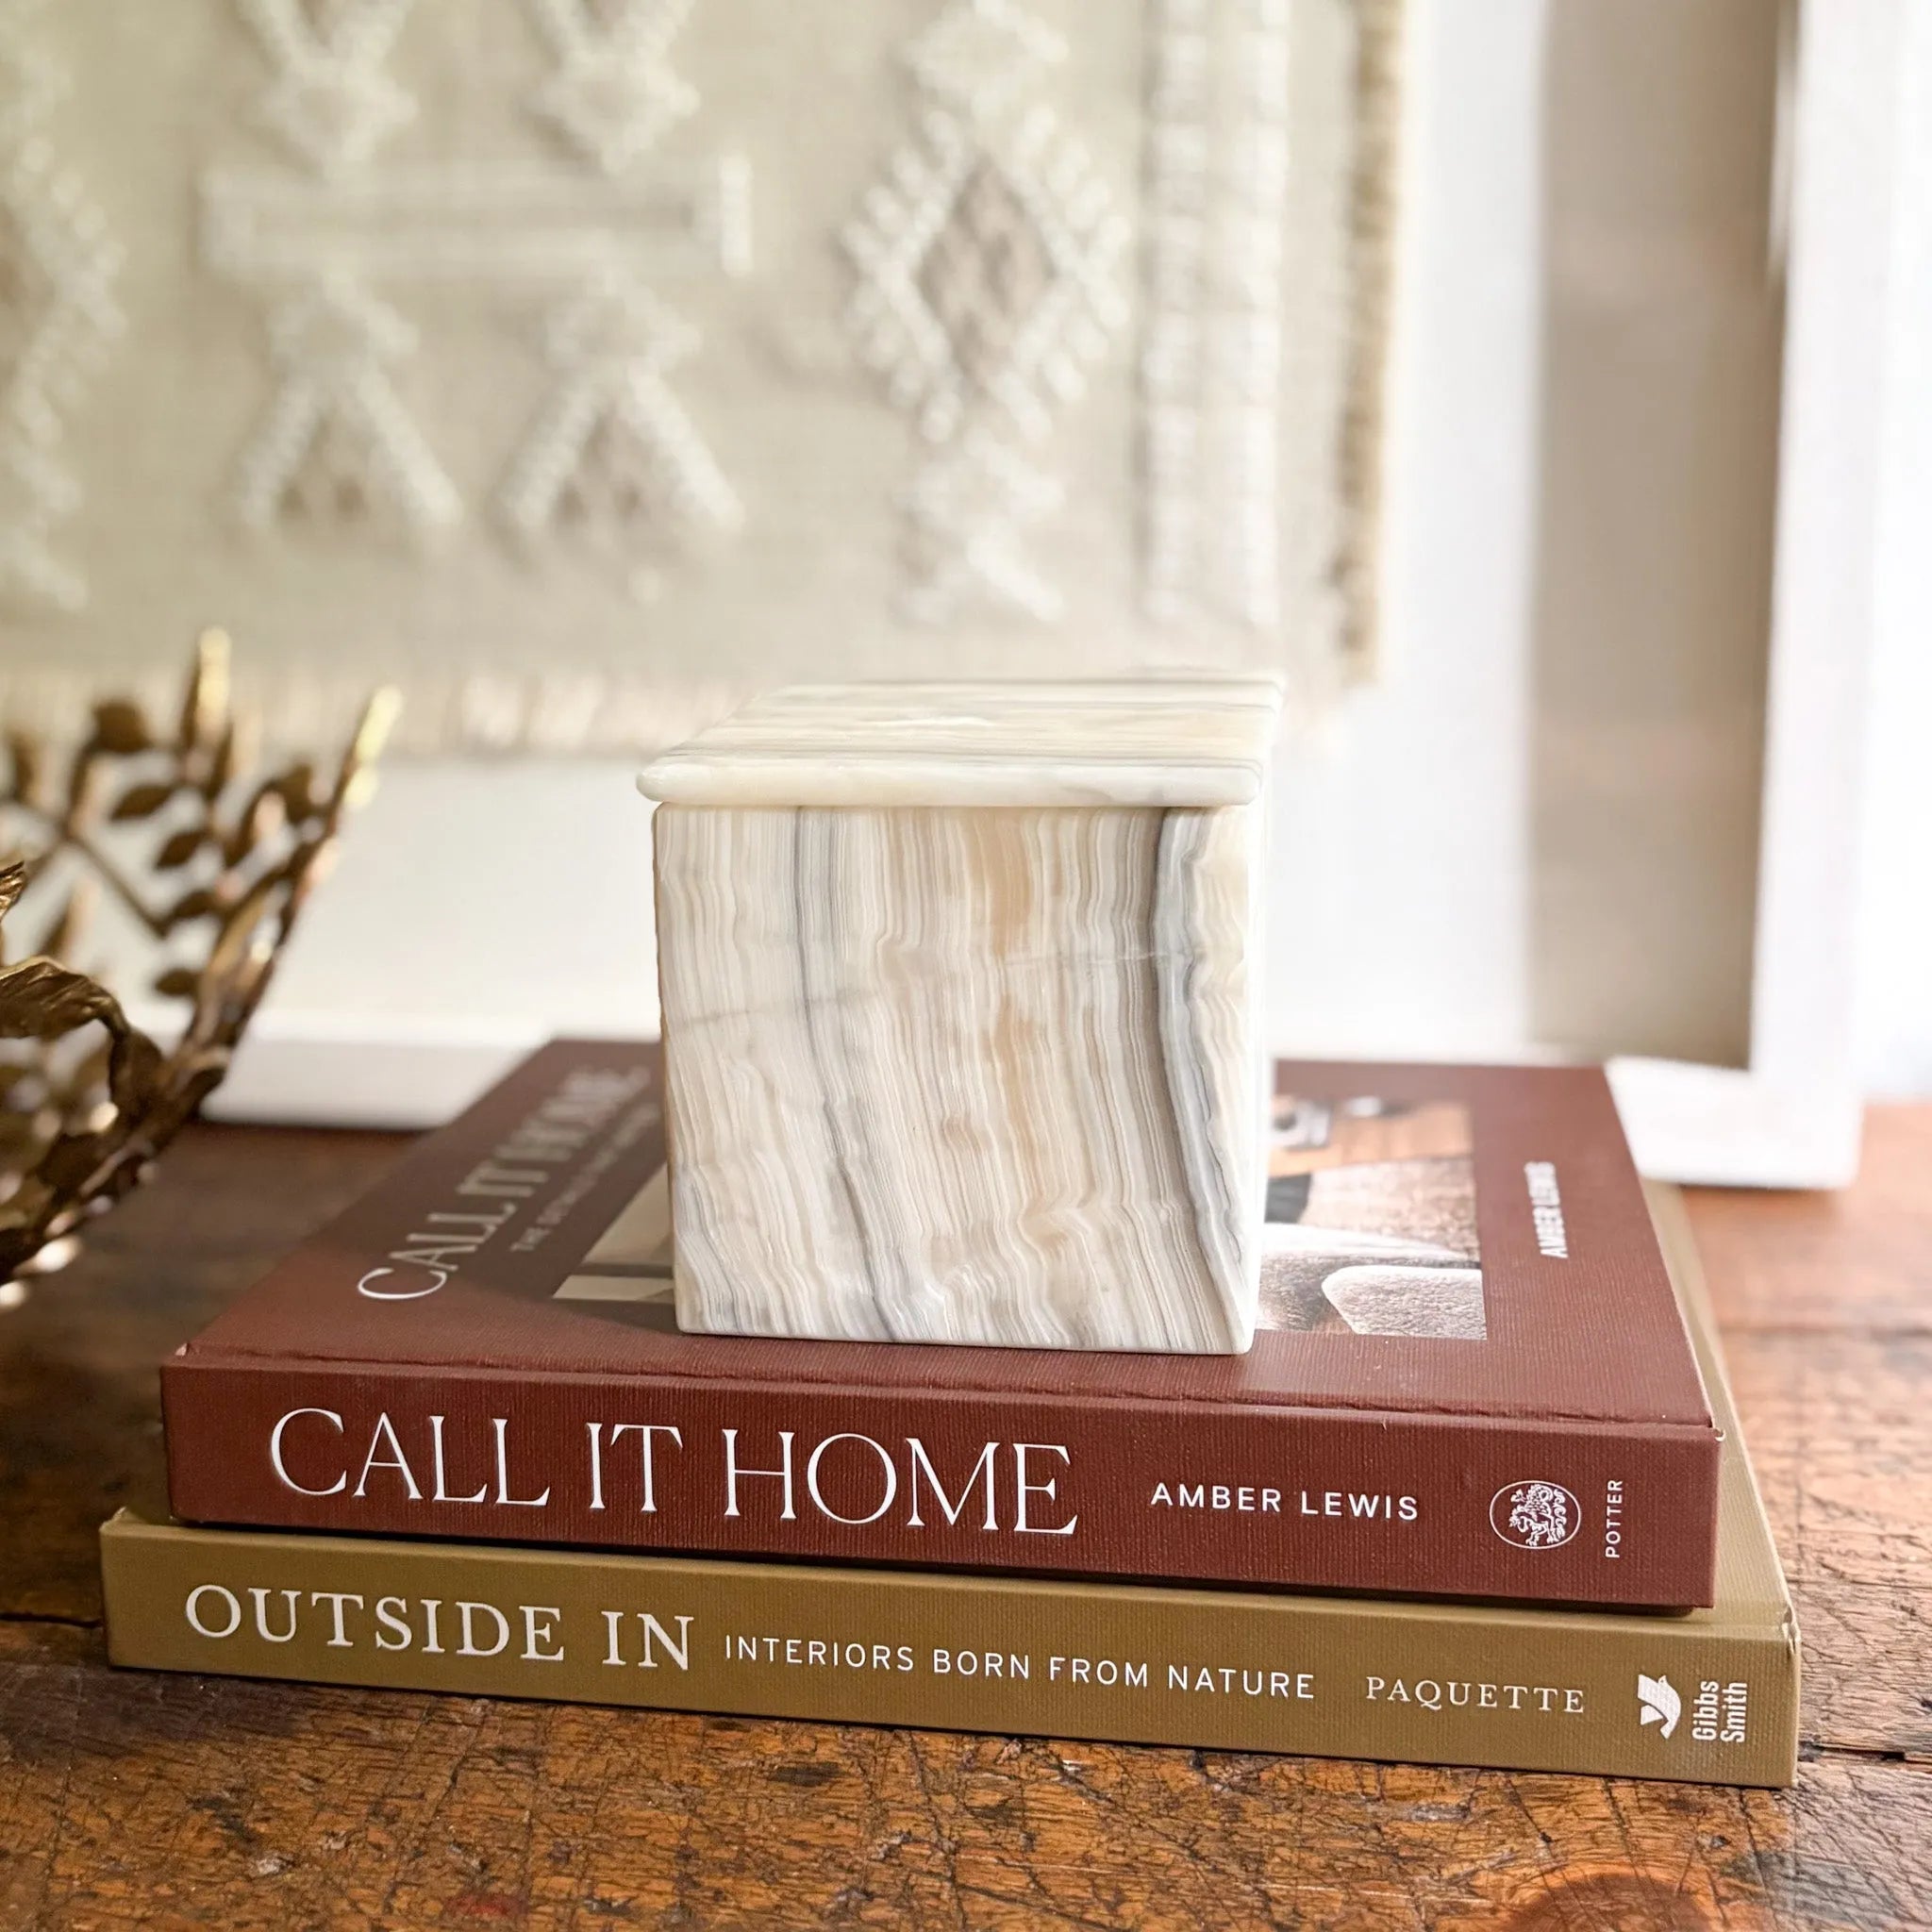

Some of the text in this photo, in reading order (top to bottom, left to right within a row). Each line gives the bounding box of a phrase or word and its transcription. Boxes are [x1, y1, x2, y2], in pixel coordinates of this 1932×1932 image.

[358, 1203, 517, 1299] CALL
[270, 1407, 1078, 1535] CALL IT HOME
[1151, 1482, 1418, 1520] AMBER LEWIS
[1605, 1479, 1624, 1558] POTTER
[185, 1584, 695, 1671] OUTSIDE IN
[725, 1635, 1314, 1699] INTERIORS BORN FROM NATURE
[1366, 1676, 1585, 1713] PAQUETTE
[1691, 1680, 1720, 1741] Gibbs
[1719, 1682, 1748, 1743] Smith
